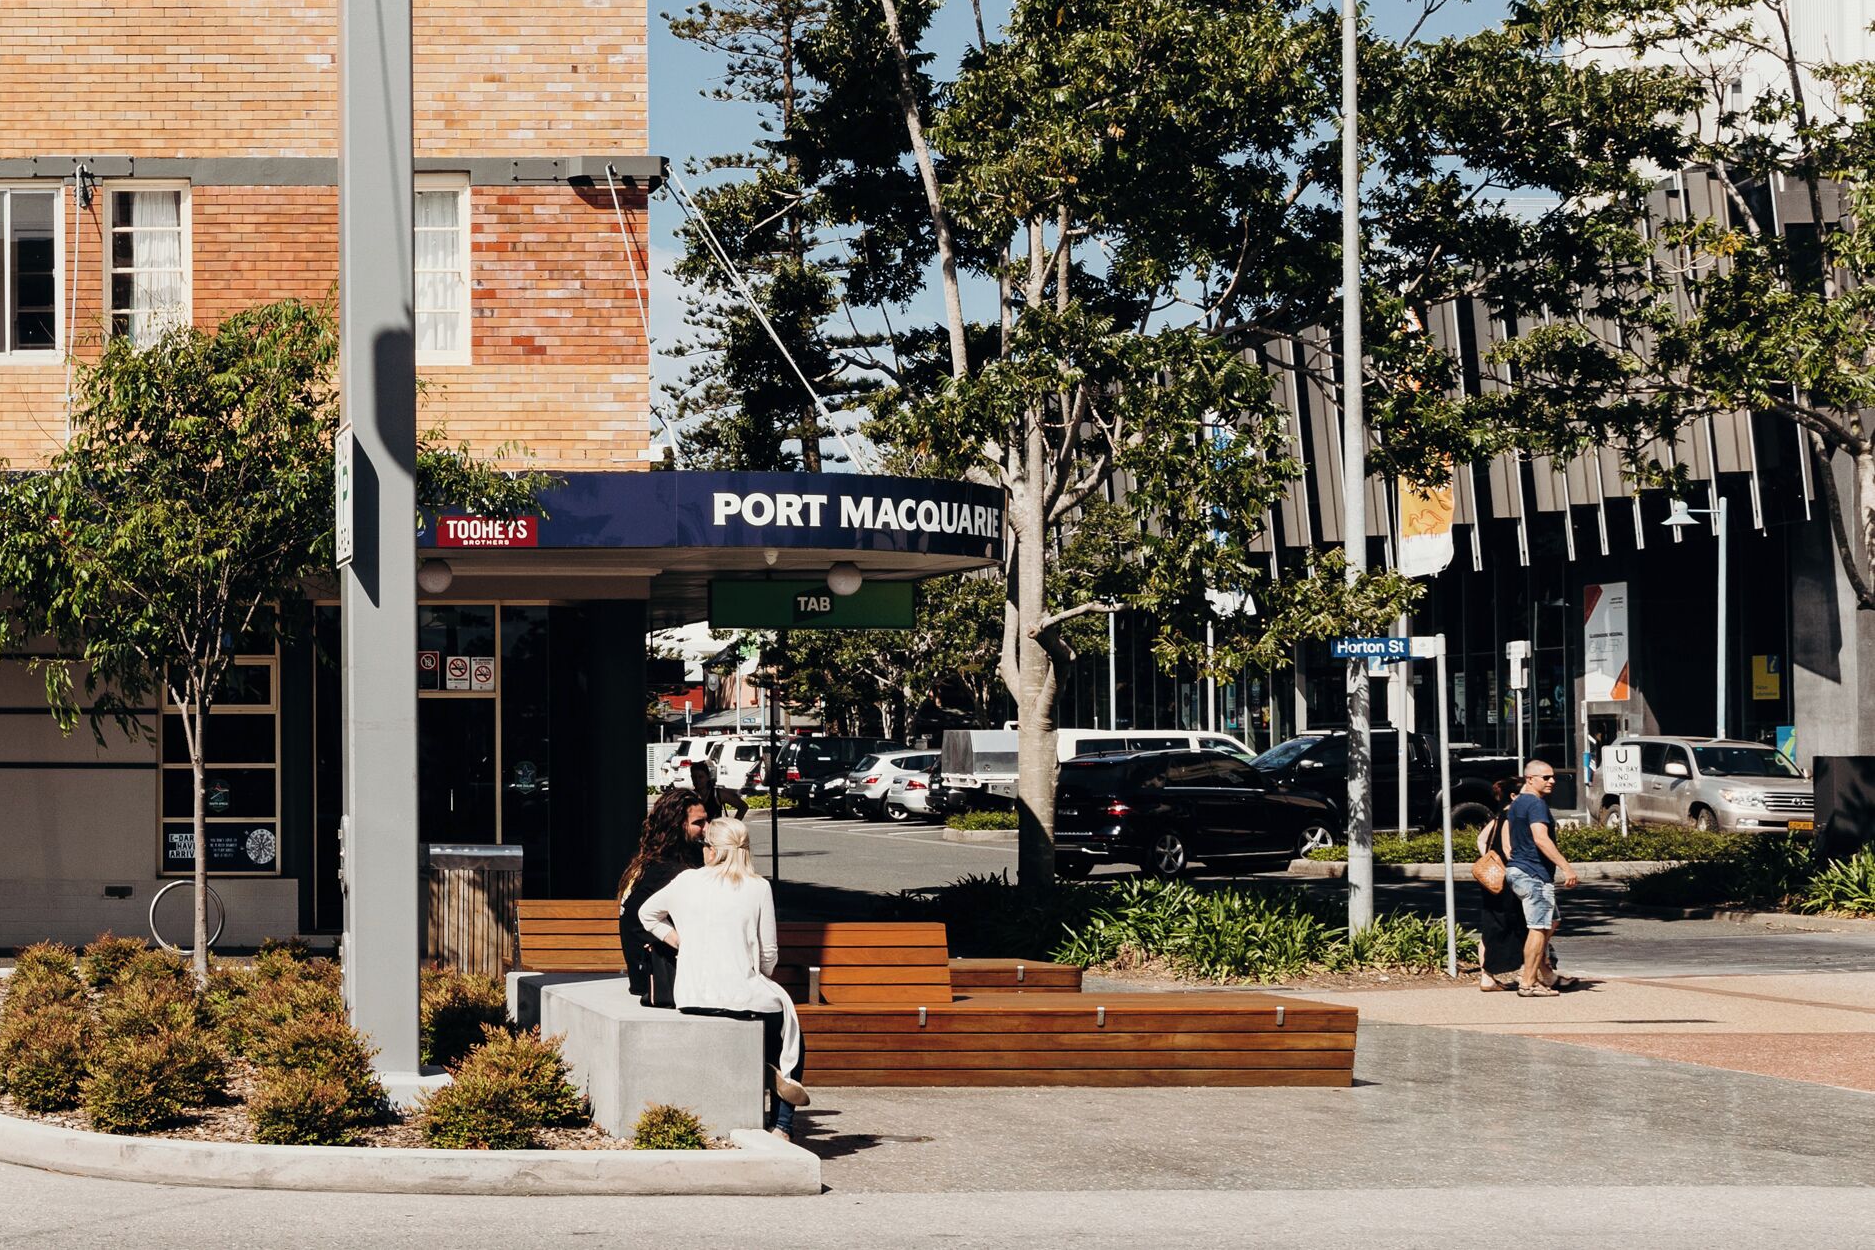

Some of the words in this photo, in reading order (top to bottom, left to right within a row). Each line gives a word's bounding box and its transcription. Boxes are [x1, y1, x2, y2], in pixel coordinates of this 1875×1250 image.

[712, 492, 827, 527] PORT
[840, 495, 1000, 539] MACQUARIE
[446, 519, 528, 539] TOOHEYS
[797, 596, 831, 612] TAB
[1337, 640, 1385, 654] Horton
[1388, 639, 1405, 654] St
[1615, 749, 1628, 764] U
[177, 842, 195, 850] HAV
[170, 850, 195, 858] ARRIV
